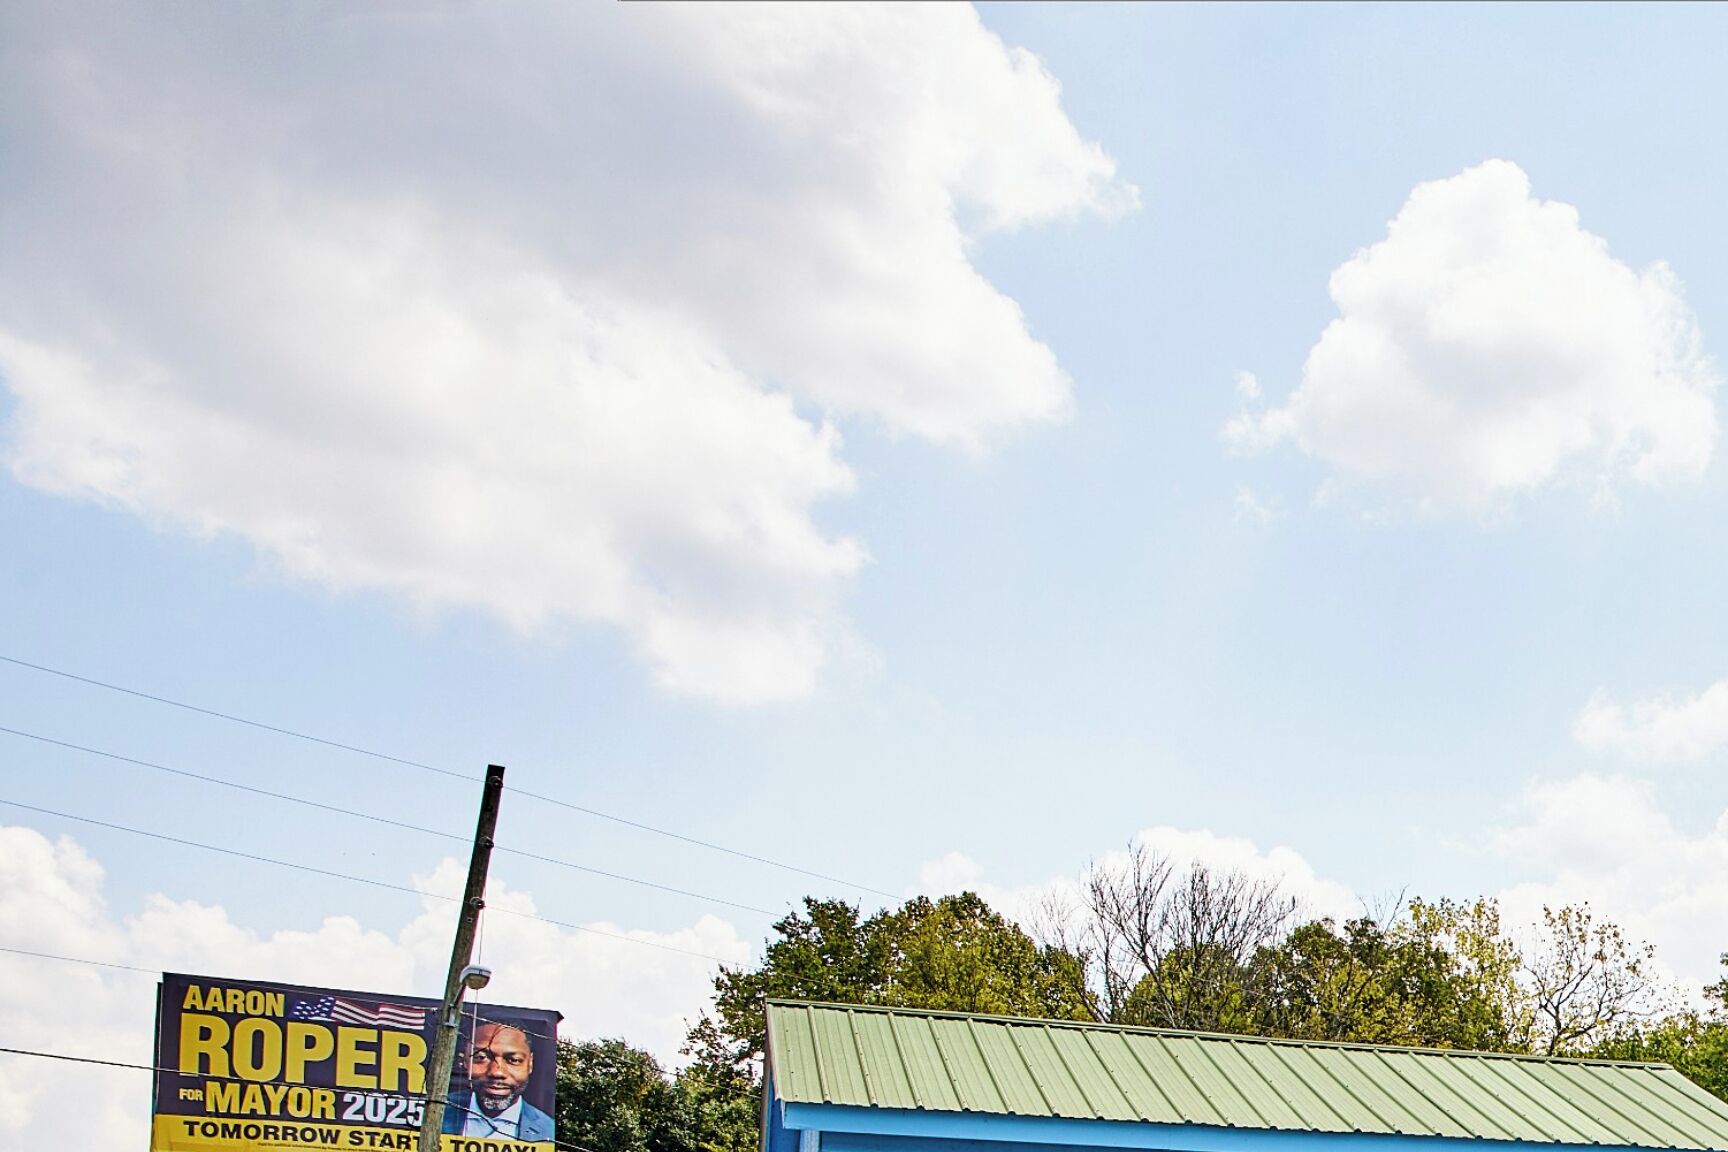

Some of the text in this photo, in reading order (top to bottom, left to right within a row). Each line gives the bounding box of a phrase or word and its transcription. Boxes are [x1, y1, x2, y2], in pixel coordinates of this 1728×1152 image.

[182, 984, 285, 1018] AARON
[179, 1012, 428, 1095] ROPER
[179, 1081, 426, 1127] FOR MAYOR 2025
[183, 1120, 341, 1145] TOMORROW
